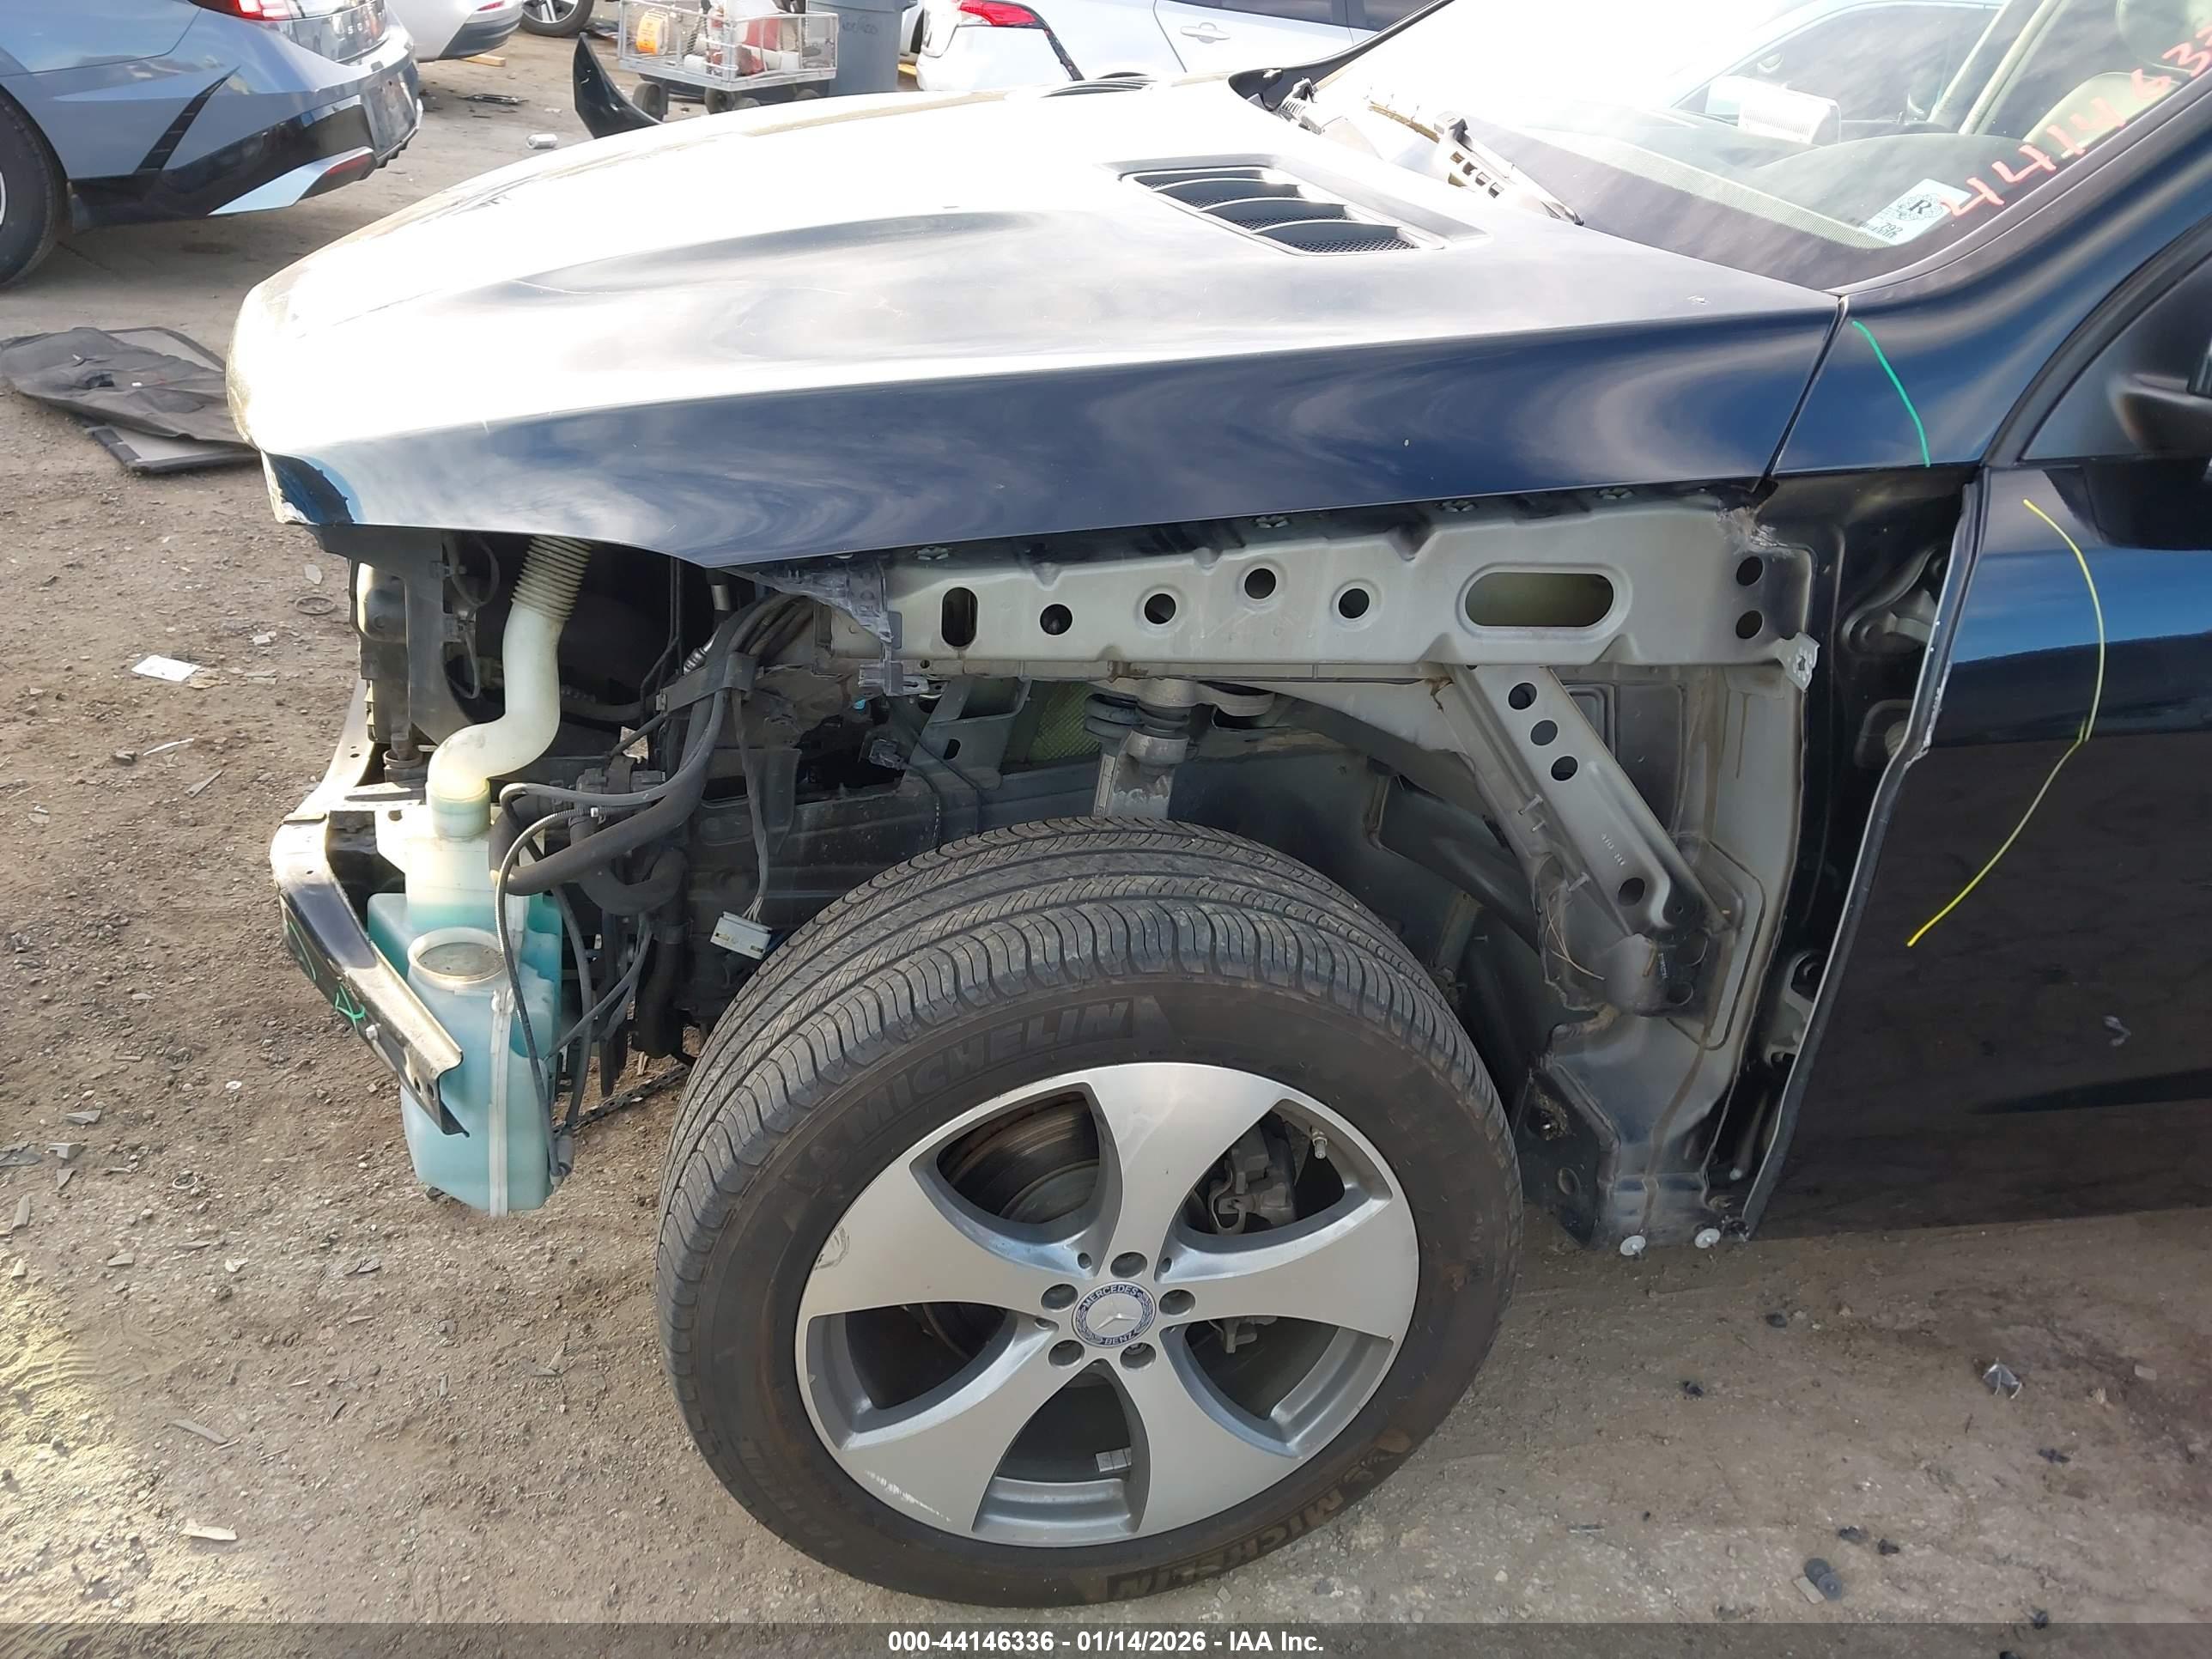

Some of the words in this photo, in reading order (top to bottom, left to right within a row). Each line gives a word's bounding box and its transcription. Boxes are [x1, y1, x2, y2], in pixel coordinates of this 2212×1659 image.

[1908, 198, 1933, 215] R
[848, 999, 1130, 1135] MICHELIN
[1082, 1284, 1139, 1309] MERCEDES
[1104, 1331, 1133, 1346] BENZ
